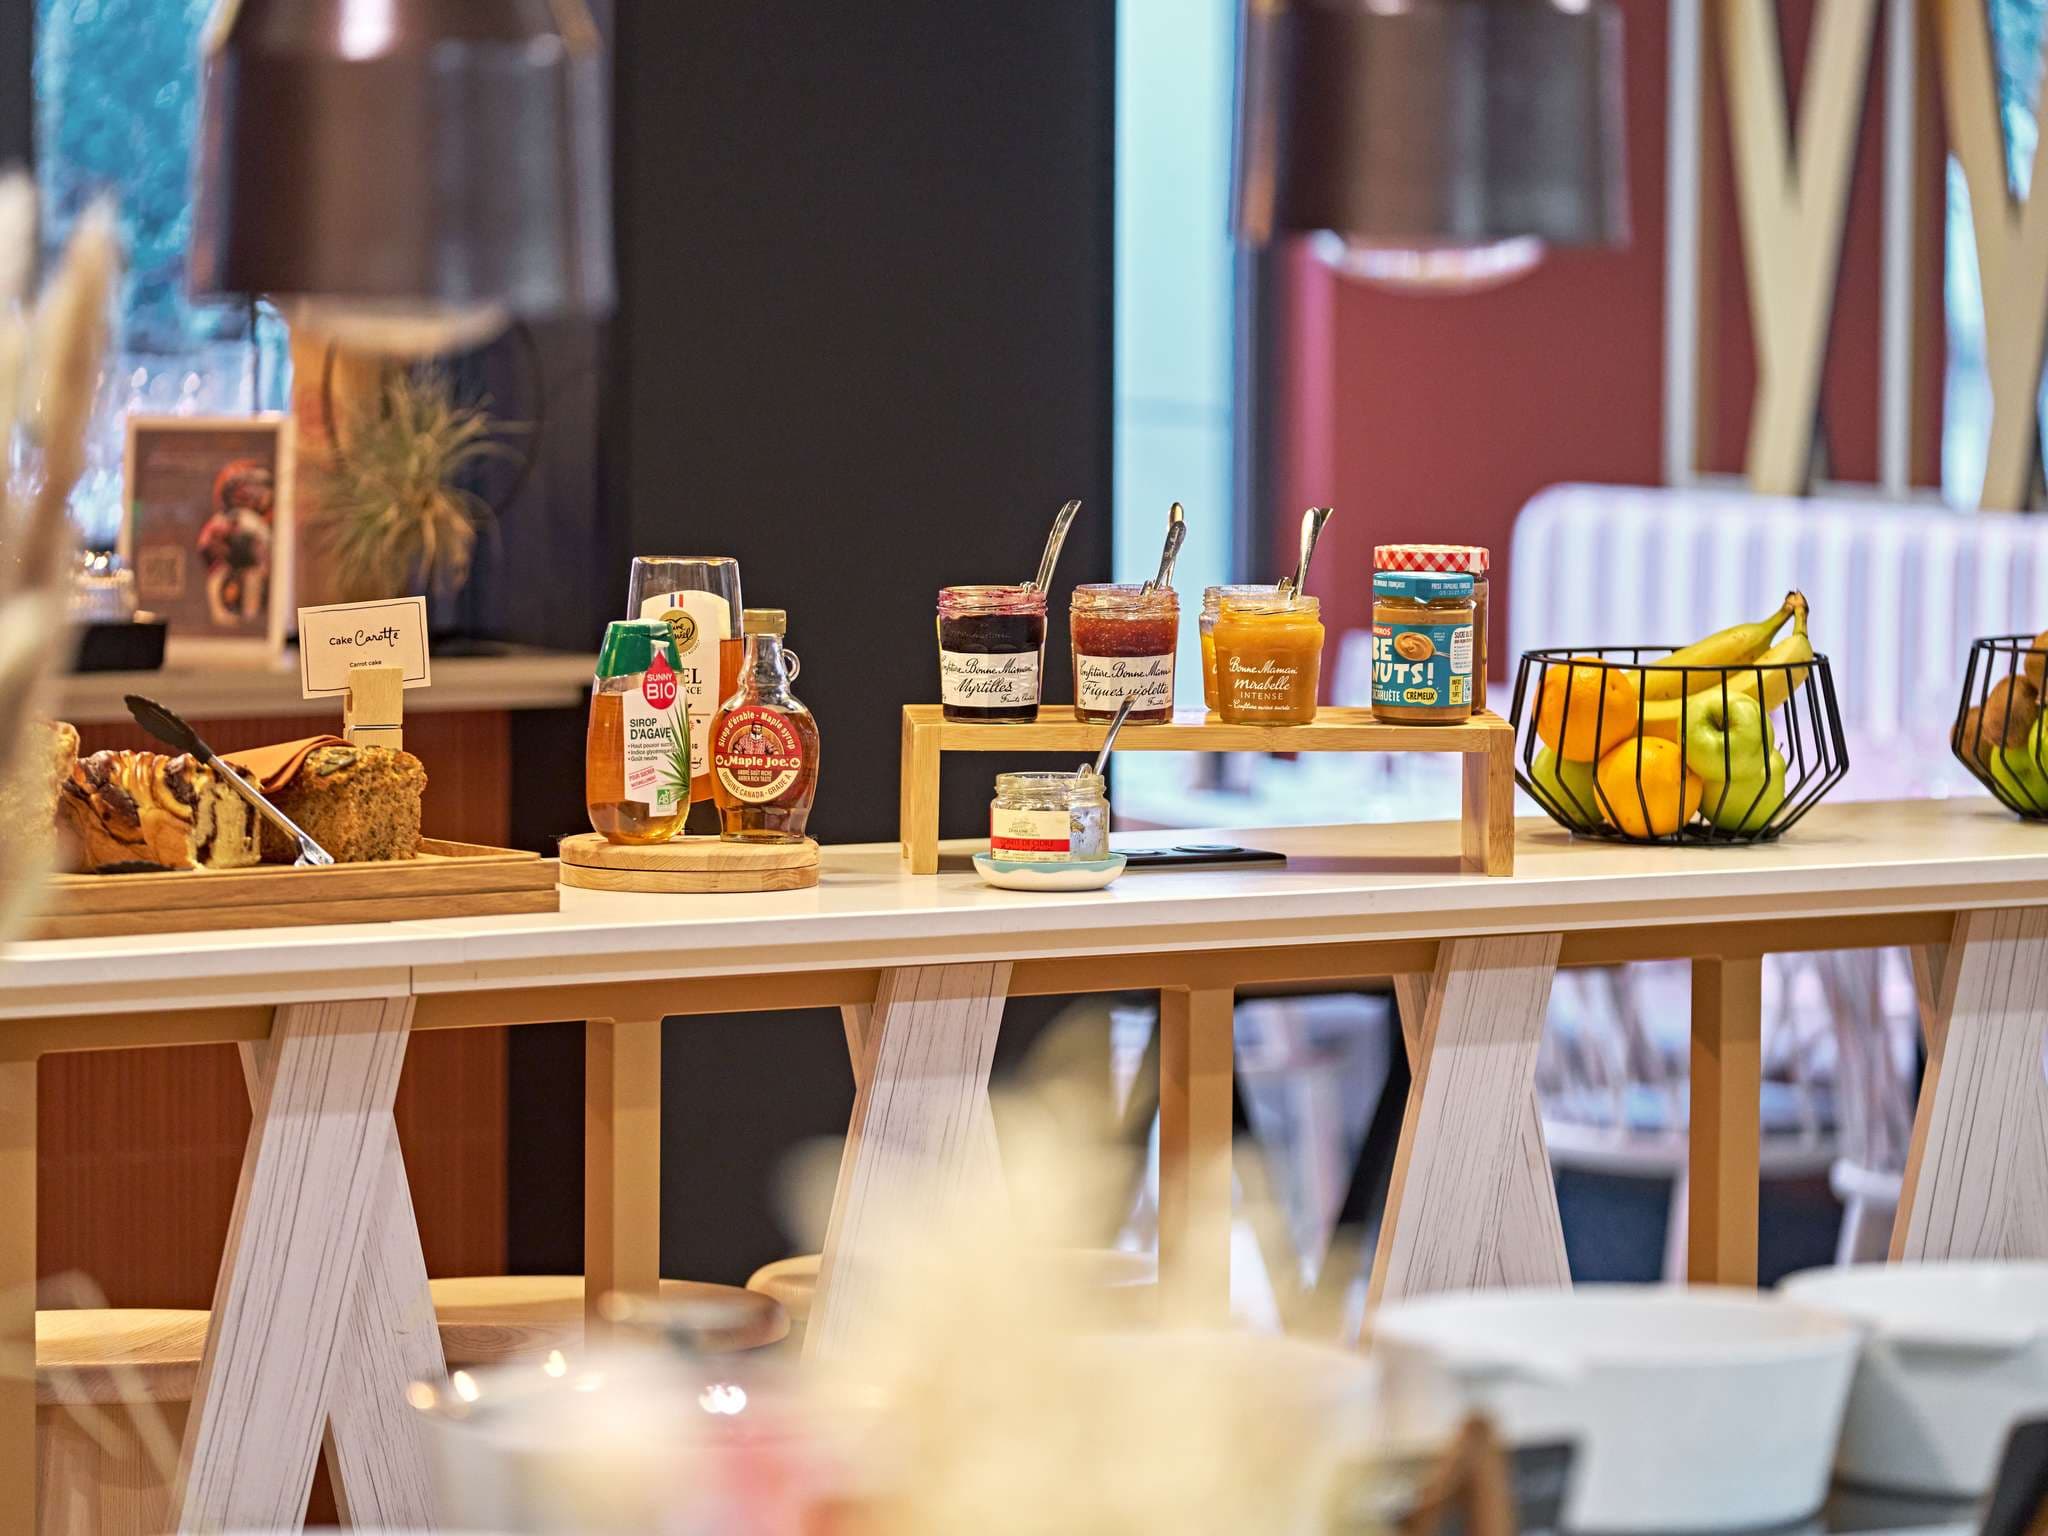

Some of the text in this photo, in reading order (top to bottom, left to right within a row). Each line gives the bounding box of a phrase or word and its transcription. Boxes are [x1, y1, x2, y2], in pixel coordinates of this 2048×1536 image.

[329, 627, 400, 648] Cake Carotte
[1373, 637, 1392, 661] BE
[965, 658, 998, 674] Bonne
[998, 657, 1034, 674] Maman
[1110, 661, 1145, 678] Bonne
[1229, 656, 1258, 673] Bonne
[1257, 660, 1298, 674] Maman
[647, 674, 672, 682] SUNNY
[683, 668, 702, 684] EL
[646, 683, 675, 700] BIO
[954, 678, 1013, 698] Myrtilles
[1082, 681, 1125, 700] Figues
[1240, 692, 1283, 700] INTENSE
[629, 718, 657, 728] SIROP
[760, 711, 783, 730] Maple
[630, 727, 671, 740] D'AGAVE
[724, 756, 763, 767] Maple
[721, 771, 765, 799] ORIGINE CANADA
[767, 778, 787, 796] GRADE
